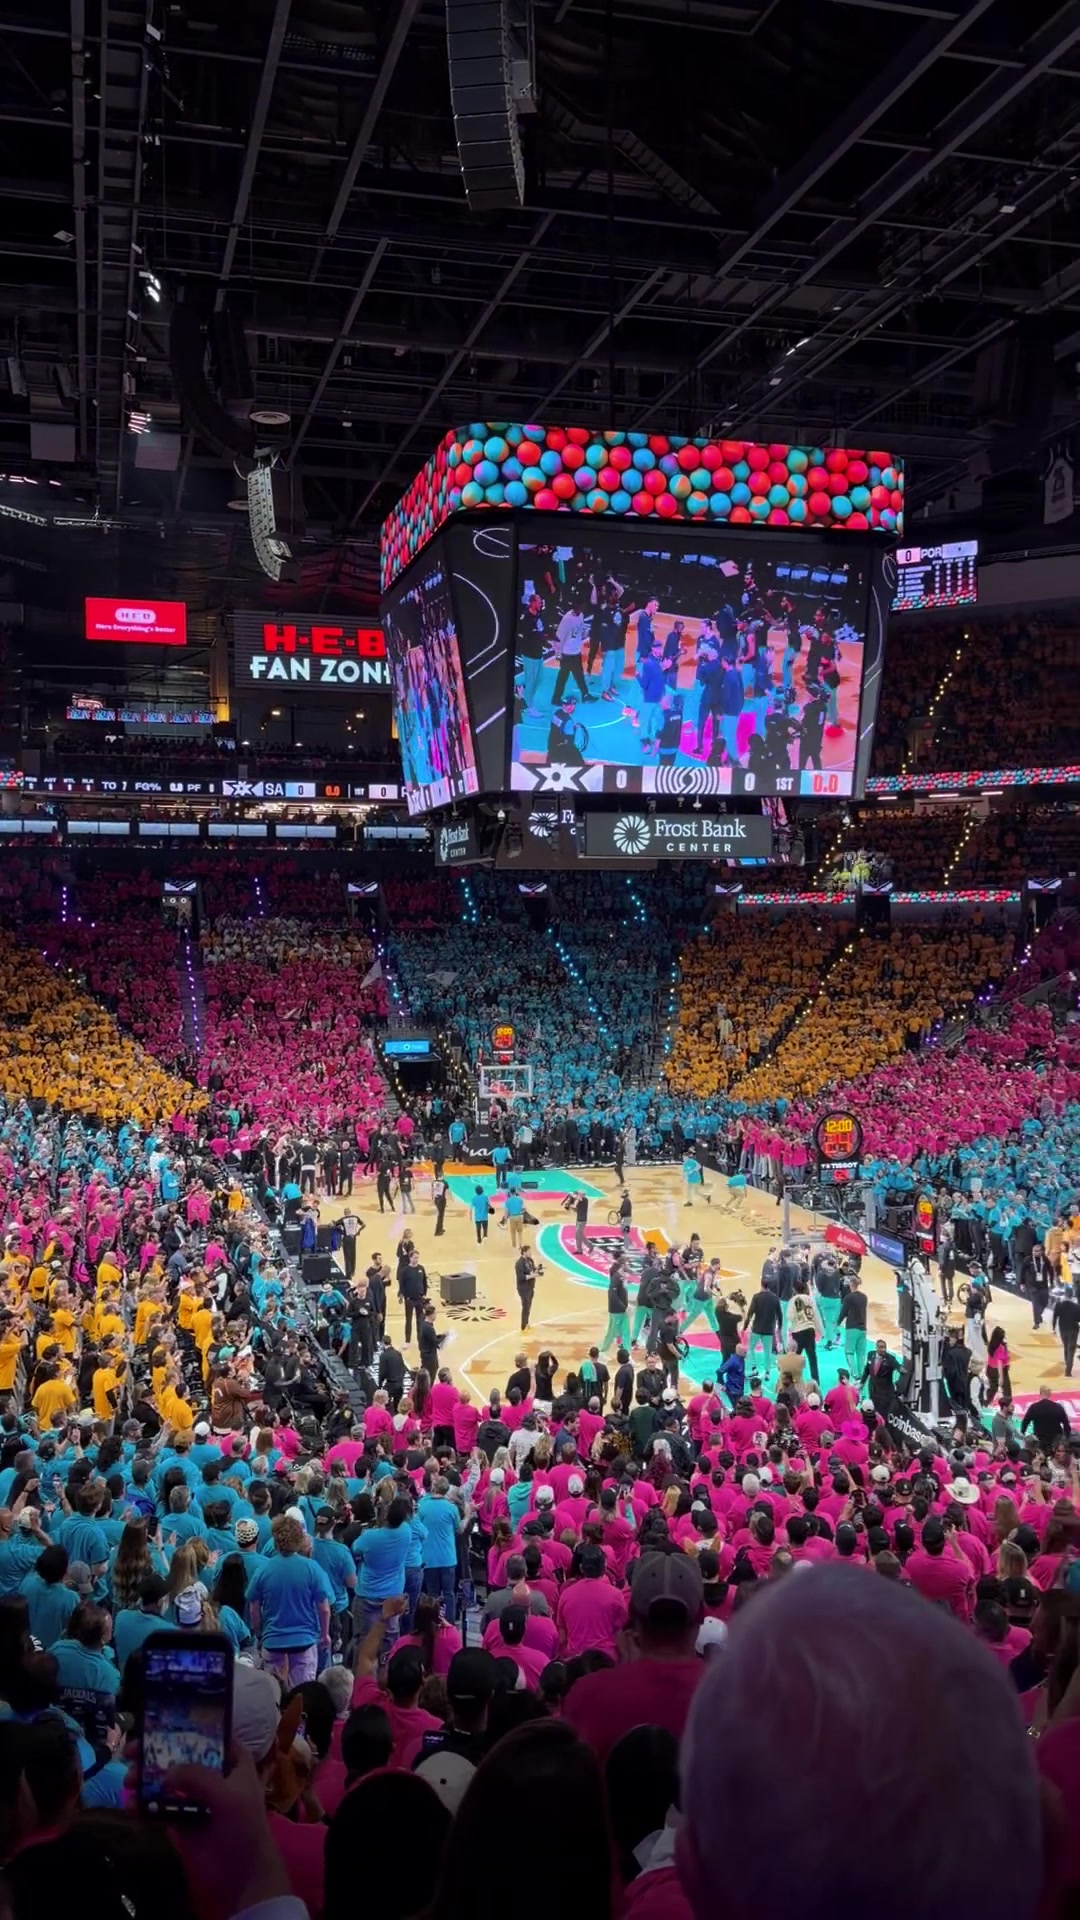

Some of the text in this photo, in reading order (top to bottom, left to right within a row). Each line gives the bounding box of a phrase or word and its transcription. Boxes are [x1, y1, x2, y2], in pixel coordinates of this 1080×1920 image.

[921, 547, 942, 559] POR
[250, 656, 311, 681] FAN
[101, 781, 117, 790] TO
[135, 782, 162, 791] FG%
[187, 783, 202, 792] PF
[616, 769, 838, 793] 0 0 1ST 0.0
[265, 783, 284, 796] SA
[325, 785, 340, 796] 0.0
[380, 786, 387, 797] 0
[654, 818, 746, 839] Frost Bank
[666, 843, 732, 853] CENTER
[831, 1161, 858, 1169] TISSOT
